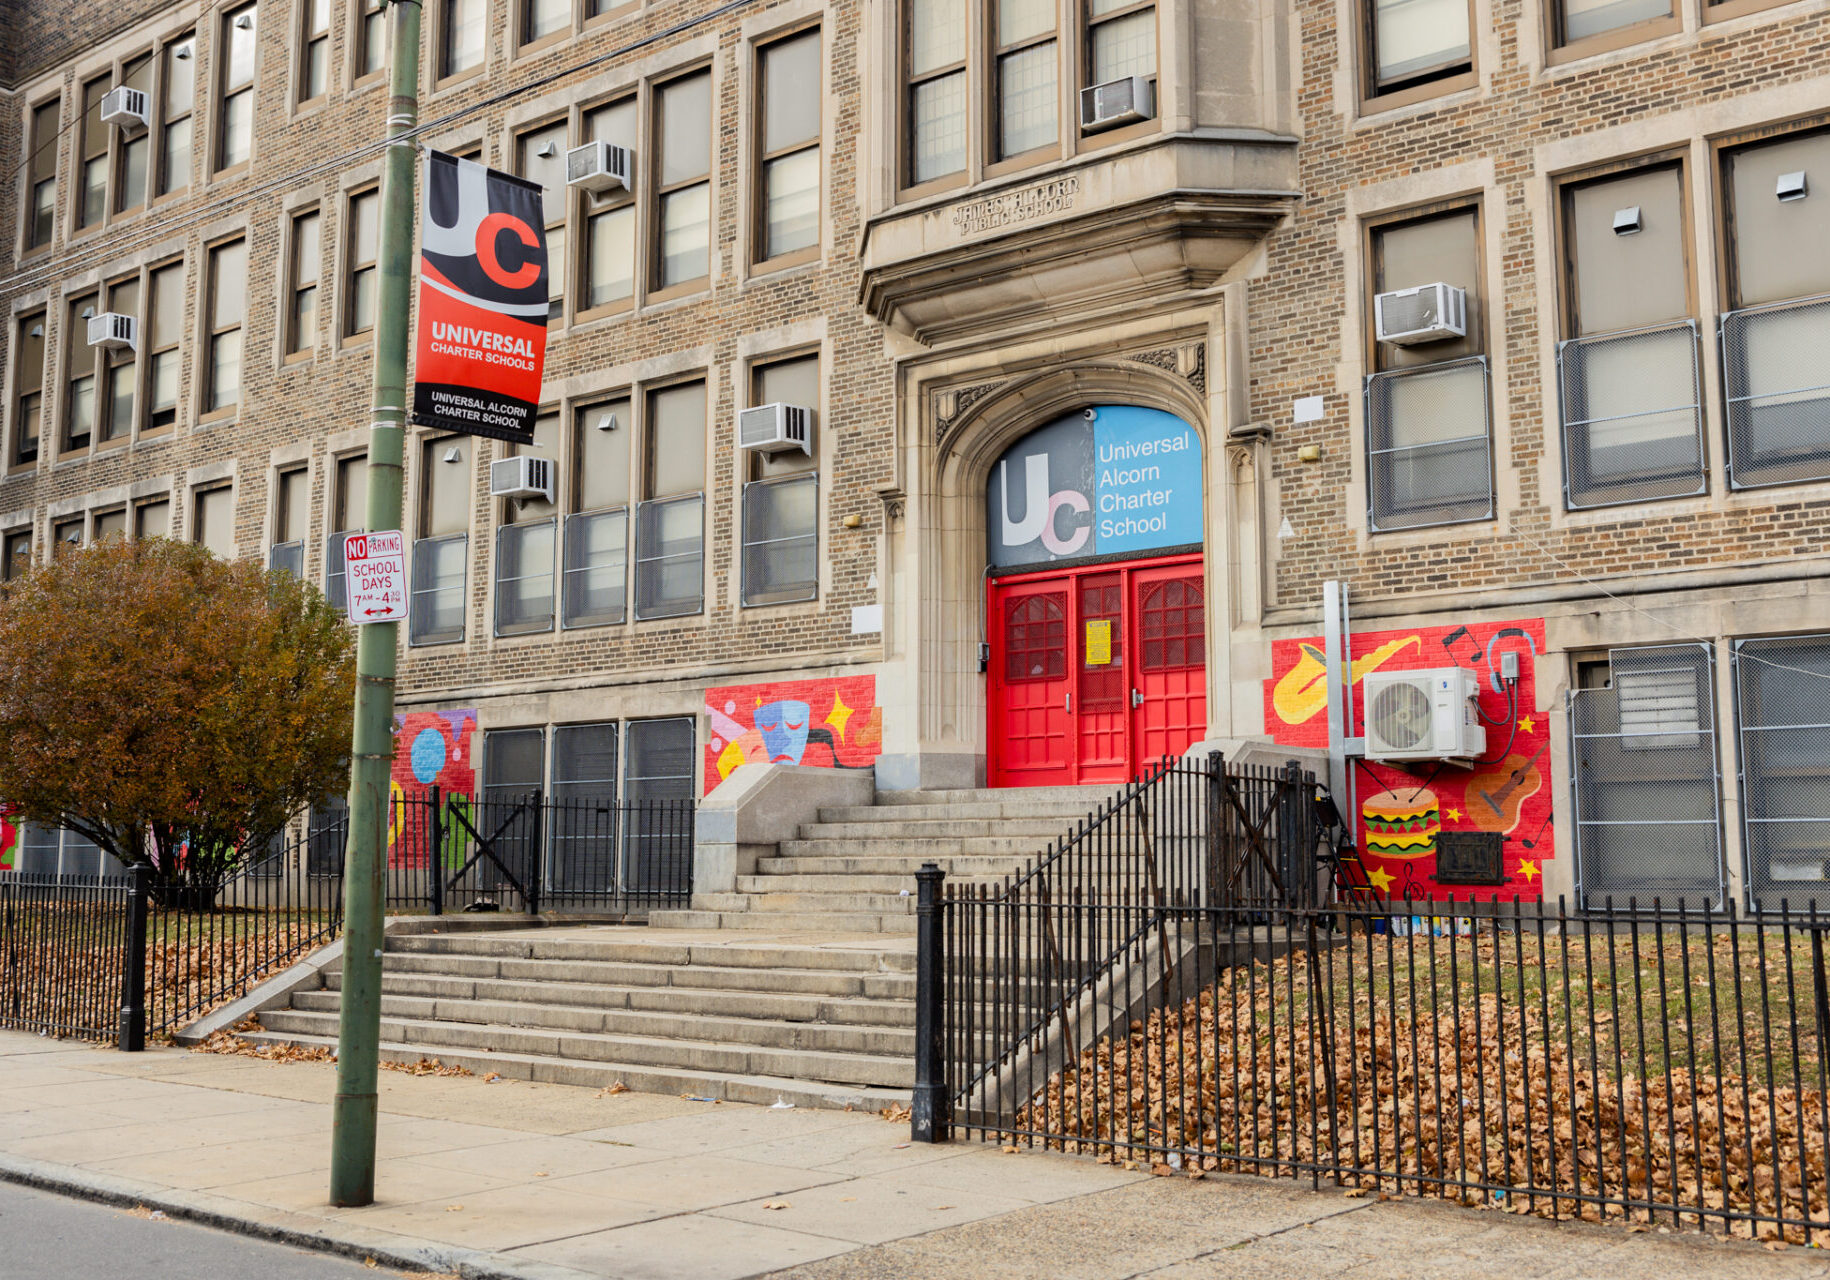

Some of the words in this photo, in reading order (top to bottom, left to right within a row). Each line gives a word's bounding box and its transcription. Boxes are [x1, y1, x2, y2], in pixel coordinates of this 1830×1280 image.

[953, 197, 1005, 225] JAMES
[1013, 177, 1080, 208] ALCORN
[422, 149, 541, 289] UC
[960, 210, 1012, 236] PUBLIC
[1014, 196, 1073, 222] SCHOOL
[431, 321, 535, 359] UNIVERSAL
[431, 342, 483, 361] CHARTER
[485, 352, 535, 371] SCHOOLS
[431, 391, 487, 410] UNIVERSAL
[487, 402, 527, 418] ALCORN
[434, 404, 481, 421] CHARTER
[482, 413, 521, 429] SCHOOL
[1099, 431, 1189, 463] Universal
[1099, 465, 1160, 489] Alcorn
[1000, 452, 1091, 556] UC
[1100, 488, 1173, 513] Charter
[1100, 512, 1167, 538] School
[347, 539, 366, 559] NO
[368, 536, 400, 553] PARKING
[353, 561, 400, 577] SCHOOL
[362, 576, 392, 591] DAYS
